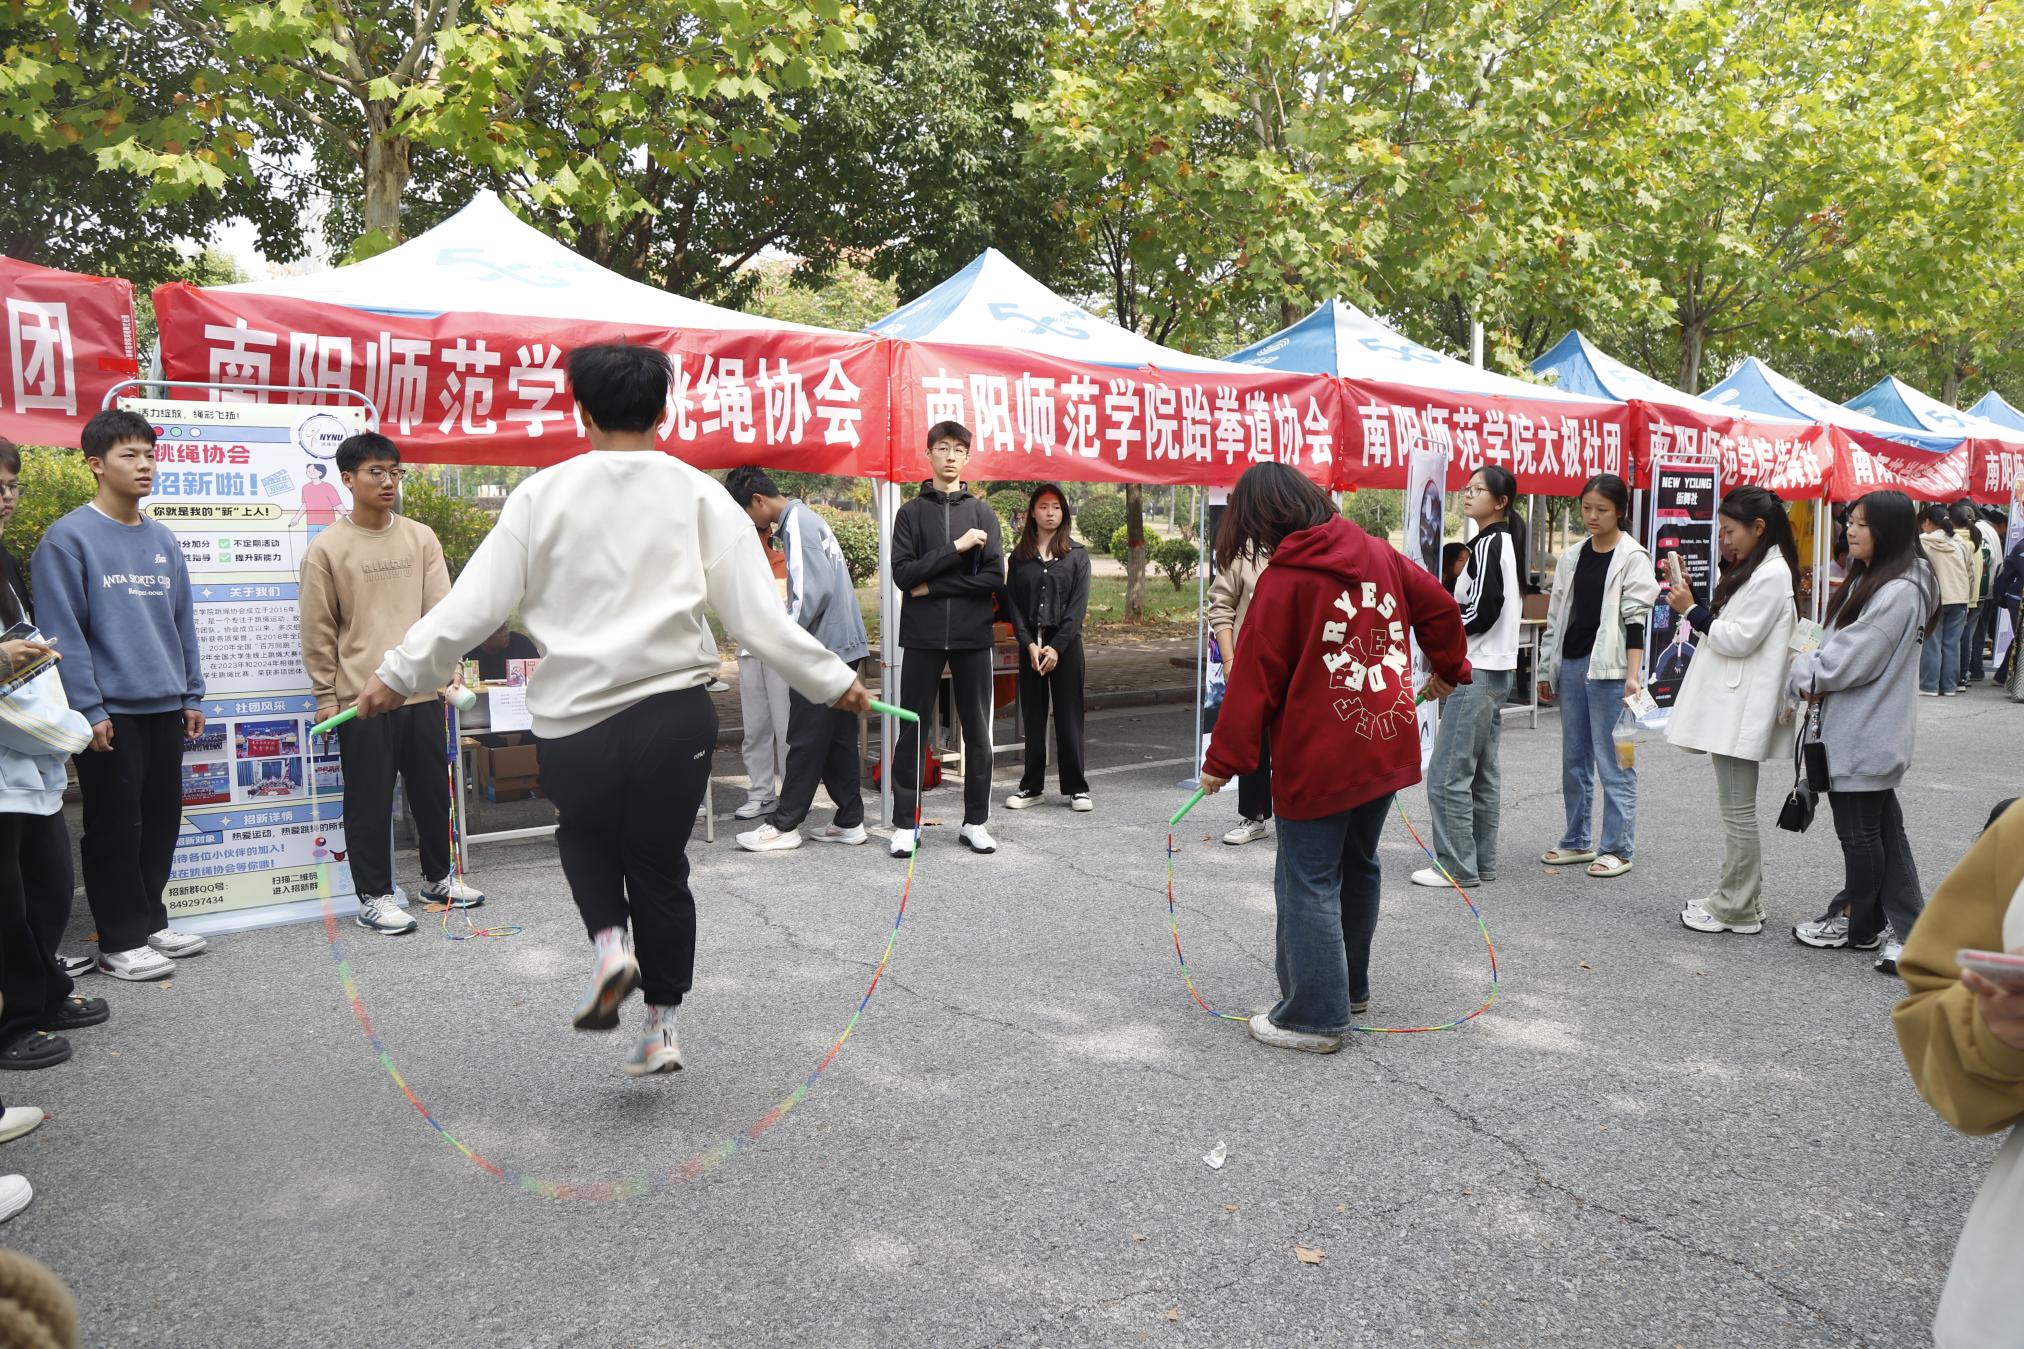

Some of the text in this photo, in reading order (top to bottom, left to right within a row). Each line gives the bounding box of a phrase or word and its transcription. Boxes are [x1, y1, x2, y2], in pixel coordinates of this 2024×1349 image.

[204, 317, 862, 448] 南阳师范学绳协会
[921, 367, 1333, 467] 南阳师范学院跆拳道协会
[319, 433, 344, 442] NYNU
[1358, 398, 1621, 478] 南阳师范学院太极社团
[153, 443, 251, 465] 跳绳协会
[1661, 477, 1712, 489] NEW YOUNG
[178, 539, 211, 549] 分加分
[233, 538, 281, 549] 不定期活动
[235, 552, 282, 563] 提升新能力
[103, 574, 127, 588] ANTA
[230, 587, 280, 598] 关于我们
[235, 701, 286, 713] 社团风采
[243, 810, 293, 825] 招新详情
[272, 871, 318, 884] 扫描二维码
[272, 882, 318, 895] 进入招新群
[169, 895, 224, 909] 849297434
